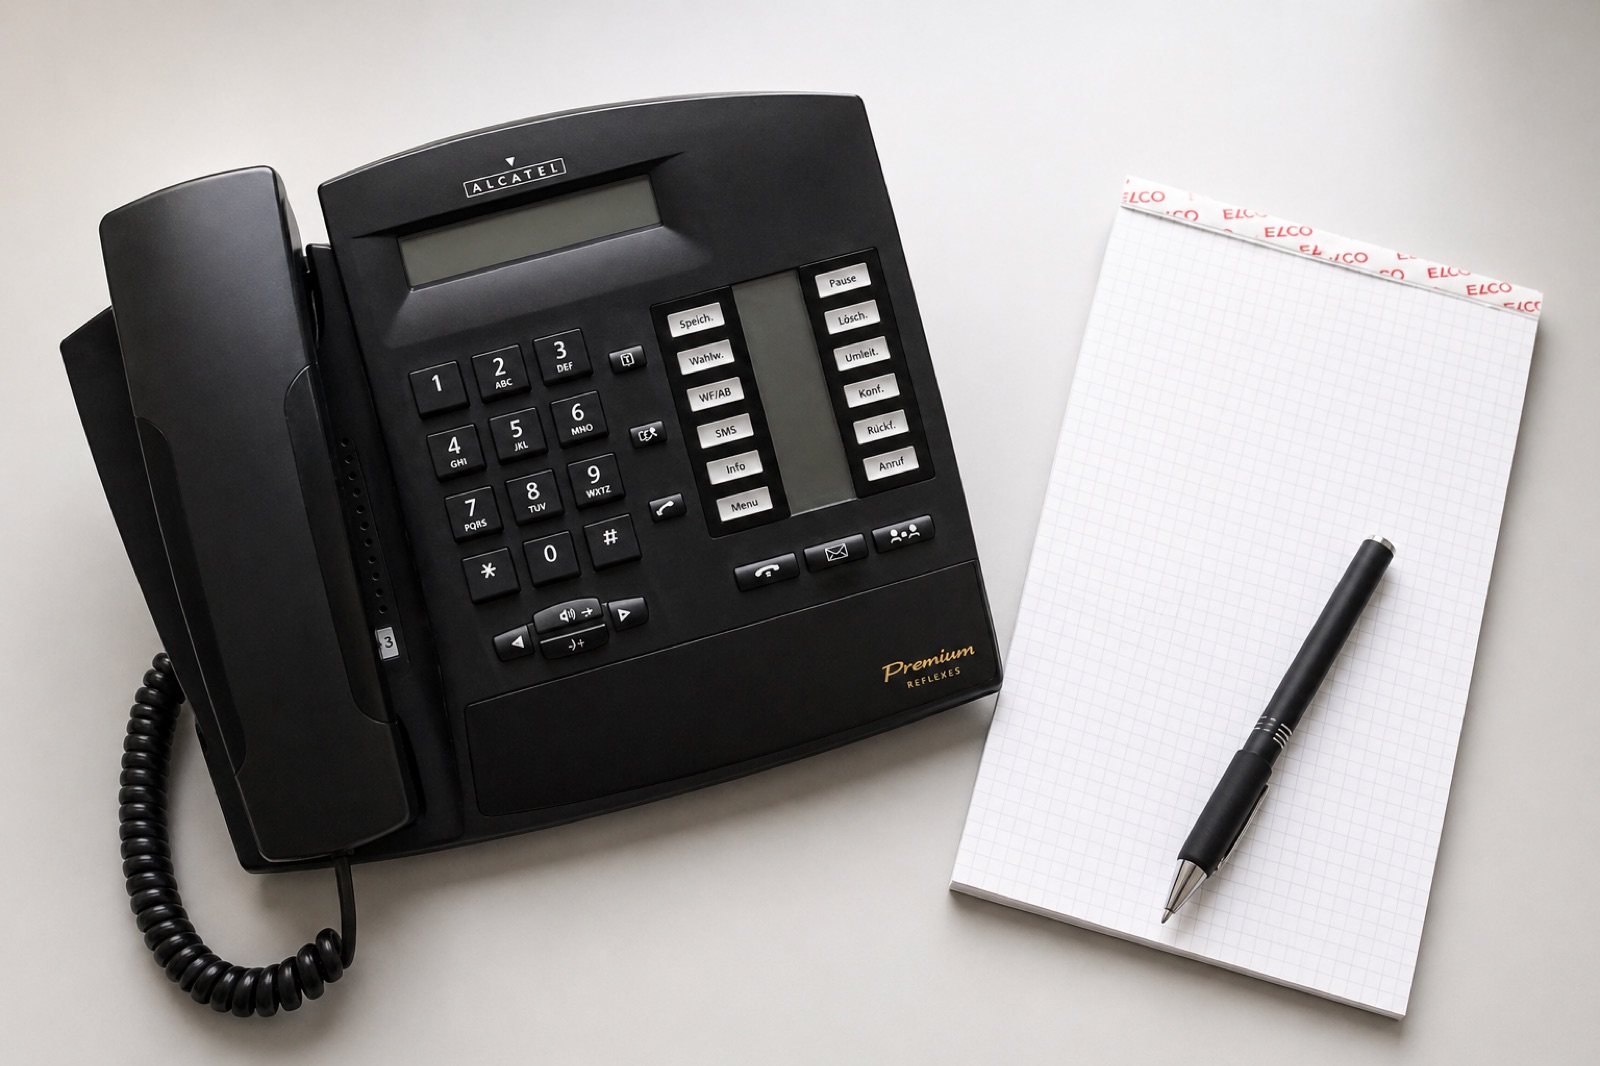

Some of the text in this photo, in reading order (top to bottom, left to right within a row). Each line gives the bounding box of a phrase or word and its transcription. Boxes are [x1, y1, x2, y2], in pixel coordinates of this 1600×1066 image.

[473, 163, 558, 193] ALCATEL
[1264, 226, 1313, 238] ELCO
[829, 274, 857, 288] Pause
[1466, 282, 1512, 296] ELCO
[679, 314, 714, 330] Speich.
[554, 341, 566, 359] 3
[845, 347, 879, 363] Umleit.
[493, 357, 506, 377] 2
[557, 362, 572, 373] DEF
[689, 352, 724, 367] Wahlw.
[432, 375, 442, 391] 1
[496, 378, 513, 389] ABC
[858, 384, 885, 398] Konf.
[699, 387, 731, 403] WF/AB
[572, 403, 584, 421] 6
[510, 419, 522, 438] 5
[715, 425, 737, 439] SMS
[448, 437, 460, 454] 4
[515, 441, 528, 451] JKL
[451, 458, 467, 468] GHI
[726, 461, 746, 475] Info
[879, 456, 905, 472] Anruf
[588, 465, 600, 484] 9
[526, 482, 540, 500] 8
[465, 498, 475, 516] 7
[528, 502, 546, 513] TUV
[731, 498, 758, 513] Menu
[465, 519, 487, 531] PQRS
[603, 529, 618, 545] #
[544, 545, 557, 562] 0
[383, 636, 394, 649] 3
[882, 645, 975, 683] Premium
[906, 666, 961, 689] REFLEXES
